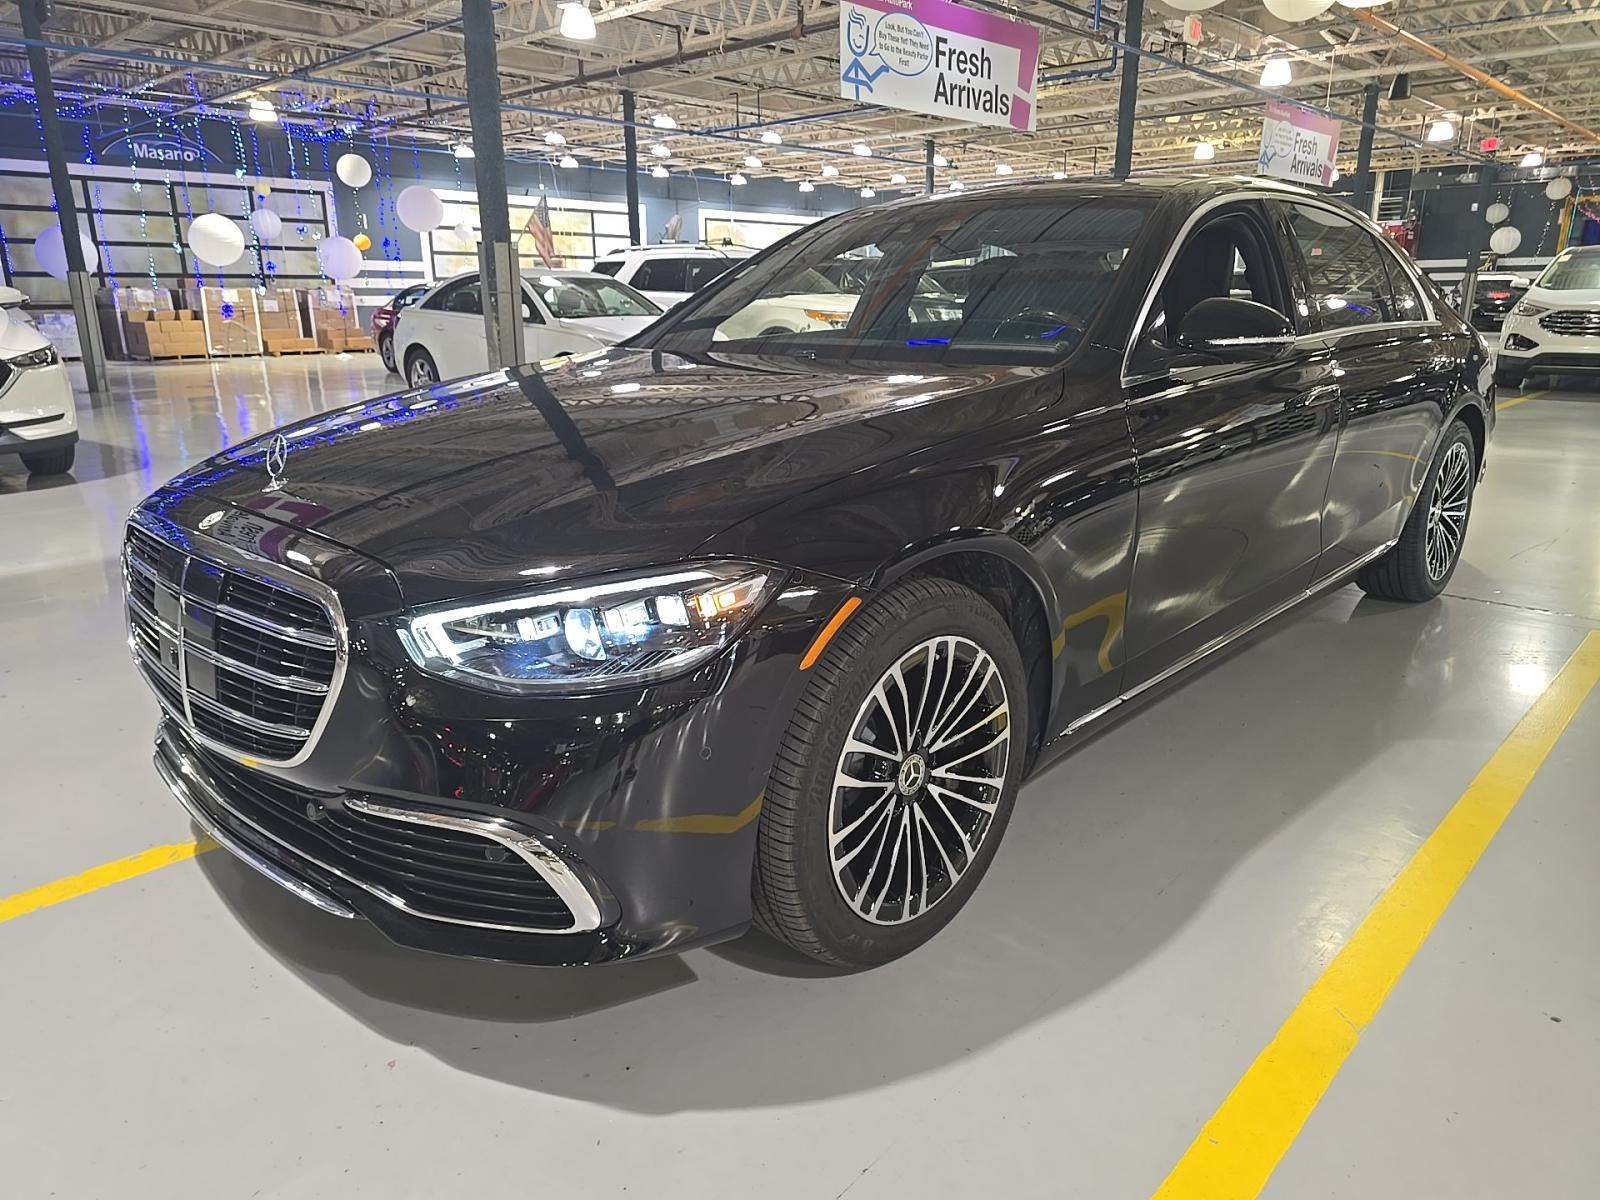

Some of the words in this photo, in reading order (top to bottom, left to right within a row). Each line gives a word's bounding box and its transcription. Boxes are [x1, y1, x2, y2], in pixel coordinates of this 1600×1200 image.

[878, 31, 887, 41] Buy
[887, 33, 899, 42] These
[909, 38, 919, 49] They
[919, 41, 929, 51] Need
[935, 35, 992, 80] Fresh
[934, 72, 1010, 116] Arrivals
[1294, 132, 1317, 156] Fresh
[1290, 154, 1322, 178] Arrivals
